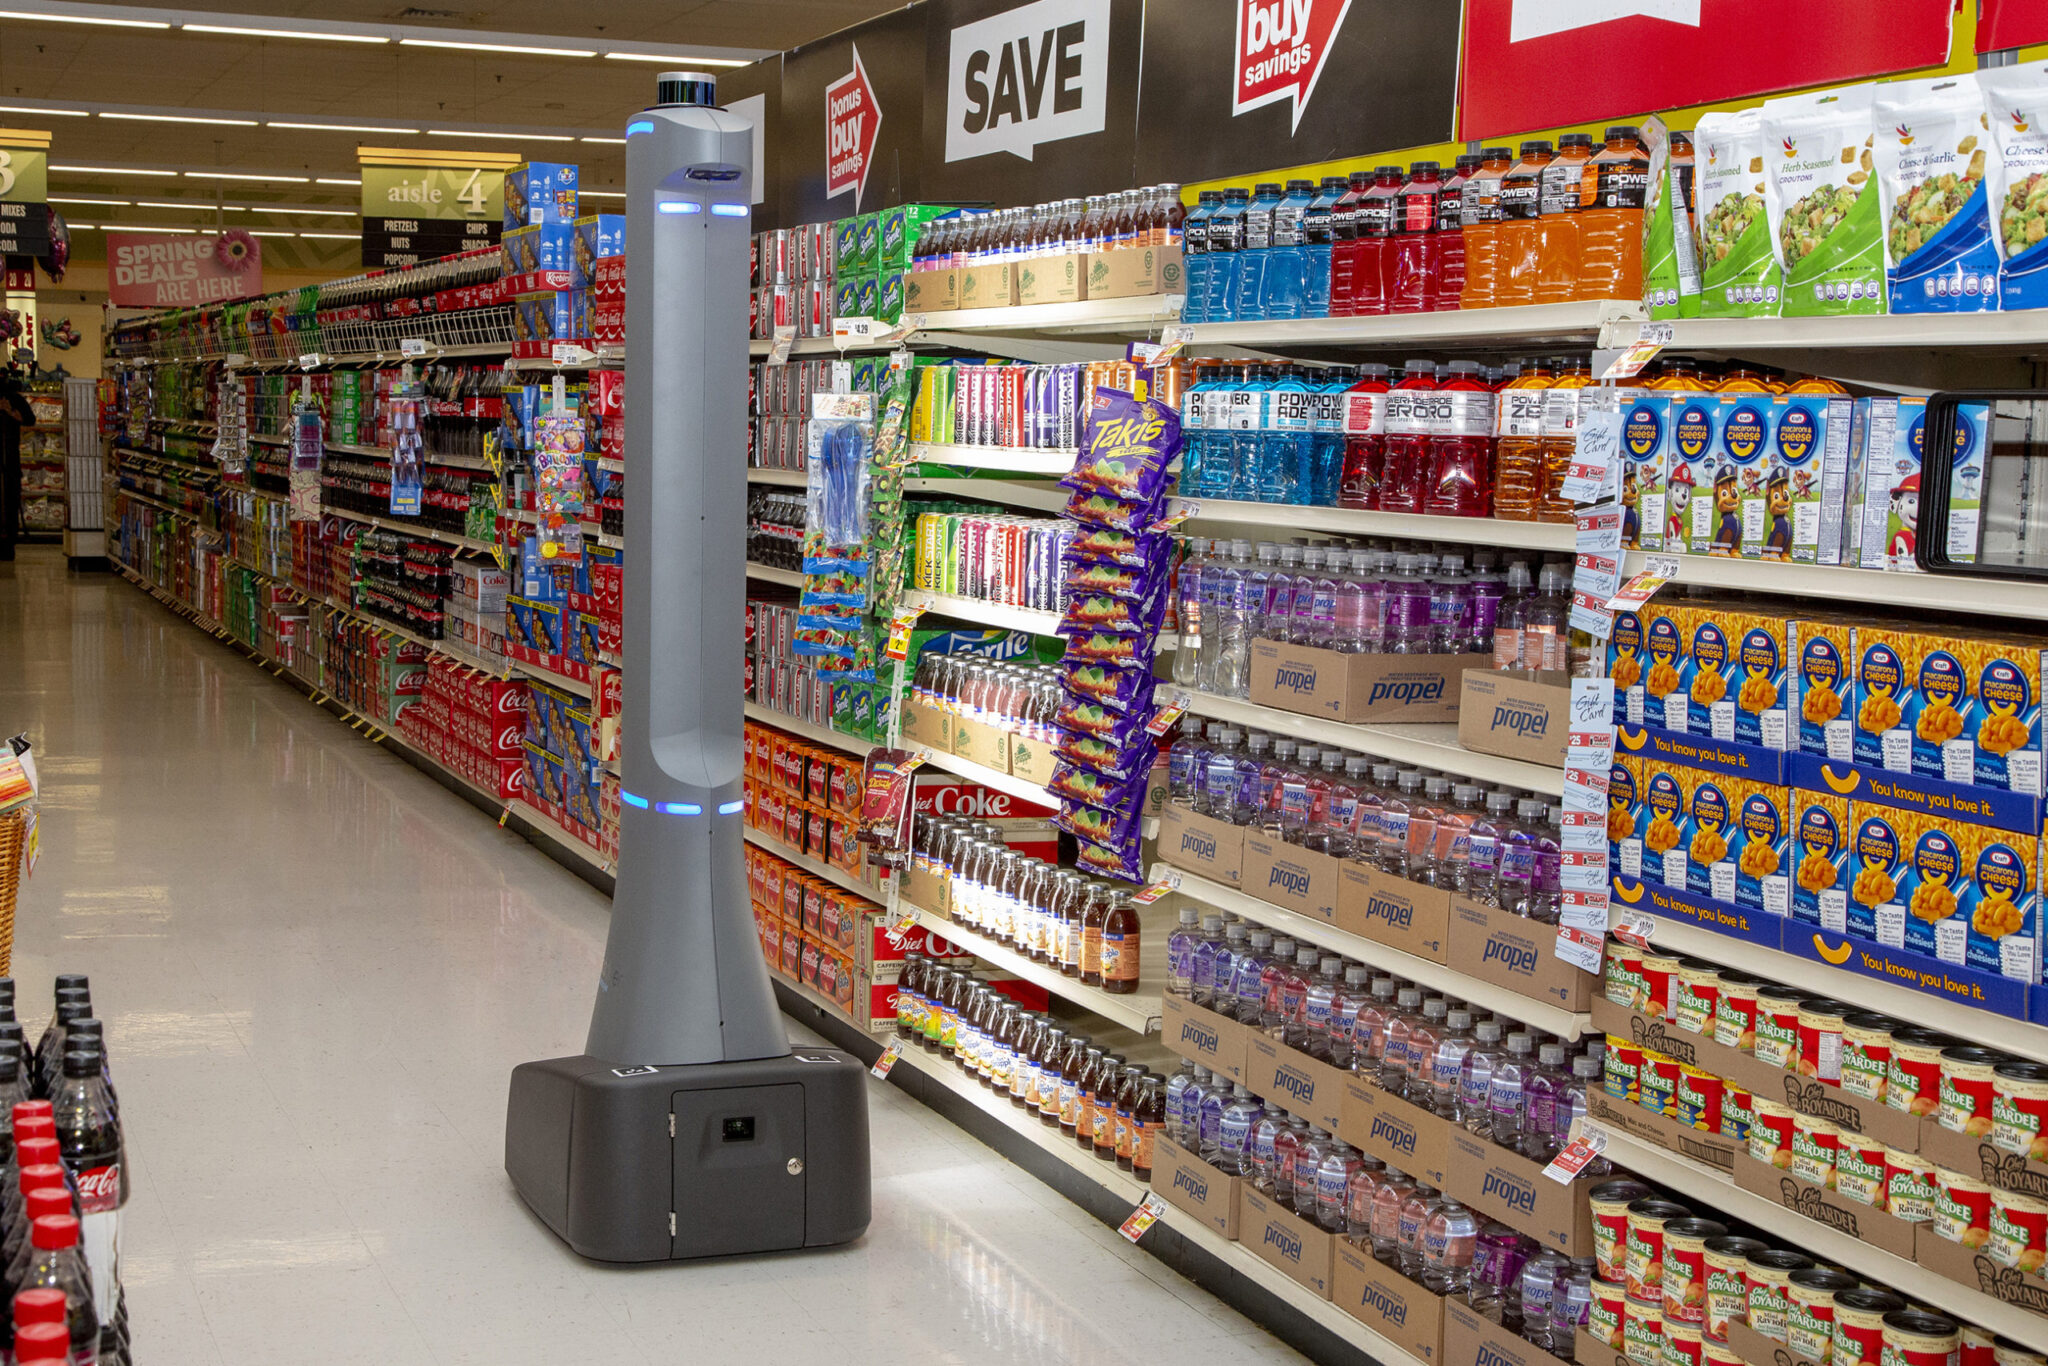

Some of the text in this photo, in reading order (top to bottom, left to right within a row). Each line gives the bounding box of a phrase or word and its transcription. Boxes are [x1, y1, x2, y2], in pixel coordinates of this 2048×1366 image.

[1247, 0, 1313, 56] buy
[1245, 43, 1311, 87] savings
[963, 21, 1085, 134] SAVE
[831, 88, 861, 121] bonus
[831, 112, 862, 159] buy
[2005, 146, 2044, 156] Cheese
[832, 151, 862, 180] savings
[1781, 156, 1834, 173] Herb Seasoned
[1779, 174, 1813, 184] CROUTONS
[388, 169, 487, 214] aisle 4
[1, 204, 26, 217] MIXES
[909, 207, 919, 215] 12
[0, 222, 17, 234] ODA
[384, 220, 488, 235] PRETZELS CHIPS
[391, 237, 490, 250] NUTS SNACKS
[882, 229, 900, 255] Sprite
[117, 240, 213, 265] SPRING
[384, 254, 418, 266] POPCORN
[116, 261, 199, 285] DEALS
[156, 276, 245, 303] ARE HERE
[956, 373, 965, 443] KICKSTART
[1277, 407, 1308, 419] ADE
[1738, 414, 1752, 422] Kraft
[1091, 418, 1166, 454] Takis
[539, 453, 582, 468] BALLOONS
[924, 522, 935, 588] KICKSTART
[935, 523, 943, 588] KICKSTART
[482, 575, 508, 585] Coke
[1574, 594, 1586, 606] $25
[1874, 653, 1888, 663] Kraft
[1933, 660, 1949, 670] Kraft
[1865, 663, 1891, 674] macaroni
[1995, 670, 2012, 679] Kraft
[1275, 667, 1317, 693] propel
[1924, 672, 1953, 682] macaroni
[1368, 676, 1446, 706] propel
[1984, 680, 2016, 691] macaroni
[1491, 706, 1550, 737] propel
[1655, 737, 1749, 768] You know you love it.
[1854, 748, 1882, 761] cheesiest
[1912, 757, 1943, 771] cheesiest
[1567, 770, 1579, 782] $25
[1974, 769, 2007, 783] cheesiest
[916, 787, 1011, 817] iet Coke
[1869, 779, 1994, 817] You know you love it.
[1563, 813, 1575, 825] $25
[1869, 827, 1884, 836] Kraft
[1181, 833, 1216, 859] propel
[1861, 836, 1887, 849] macaroni
[1929, 840, 1945, 849] Kraft
[1561, 853, 1574, 864] $25
[1919, 849, 1948, 862] macaroni
[1993, 853, 2010, 863] Kraft
[1981, 863, 2012, 876] macaroni
[1269, 867, 1311, 894] propel
[1562, 892, 1576, 903] $25
[1366, 897, 1413, 927] propel
[1651, 891, 1750, 931] You know you love it.
[1559, 926, 1571, 938] $25
[889, 935, 923, 951] Diet
[1905, 934, 1934, 949] cheesiest
[1483, 938, 1539, 971] propel
[1967, 951, 1999, 966] cheesiest
[1861, 952, 1985, 1000] You know you love it.
[1181, 1023, 1219, 1052] propel
[1644, 1035, 1696, 1066] BOYARDEE
[1273, 1069, 1315, 1099] propel
[1843, 1075, 1870, 1089] Ravioli
[1801, 1097, 1861, 1132] BOYARDEE
[1370, 1117, 1417, 1155] propel
[1994, 1130, 2022, 1145] Ravioli
[1794, 1161, 1819, 1175] Ravioli
[1173, 1169, 1208, 1202] propel
[1839, 1179, 1867, 1193] Ravioli
[1894, 1173, 1911, 1184] Chef
[1482, 1172, 1537, 1212] propel
[1889, 1182, 1935, 1198] BOYARD
[1898, 1204, 1932, 1218] Ravioli
[1798, 1202, 1859, 1239] BOYARDEE
[1710, 1273, 1725, 1283] Chef
[1752, 1286, 1767, 1297] Chef
[1714, 1298, 1745, 1312] Ravioli
[1722, 1296, 1736, 1304] Mini
[1756, 1315, 1787, 1329] Ravioli
[1763, 1311, 1778, 1320] Mini
[1790, 1334, 1817, 1349] Ravioli
